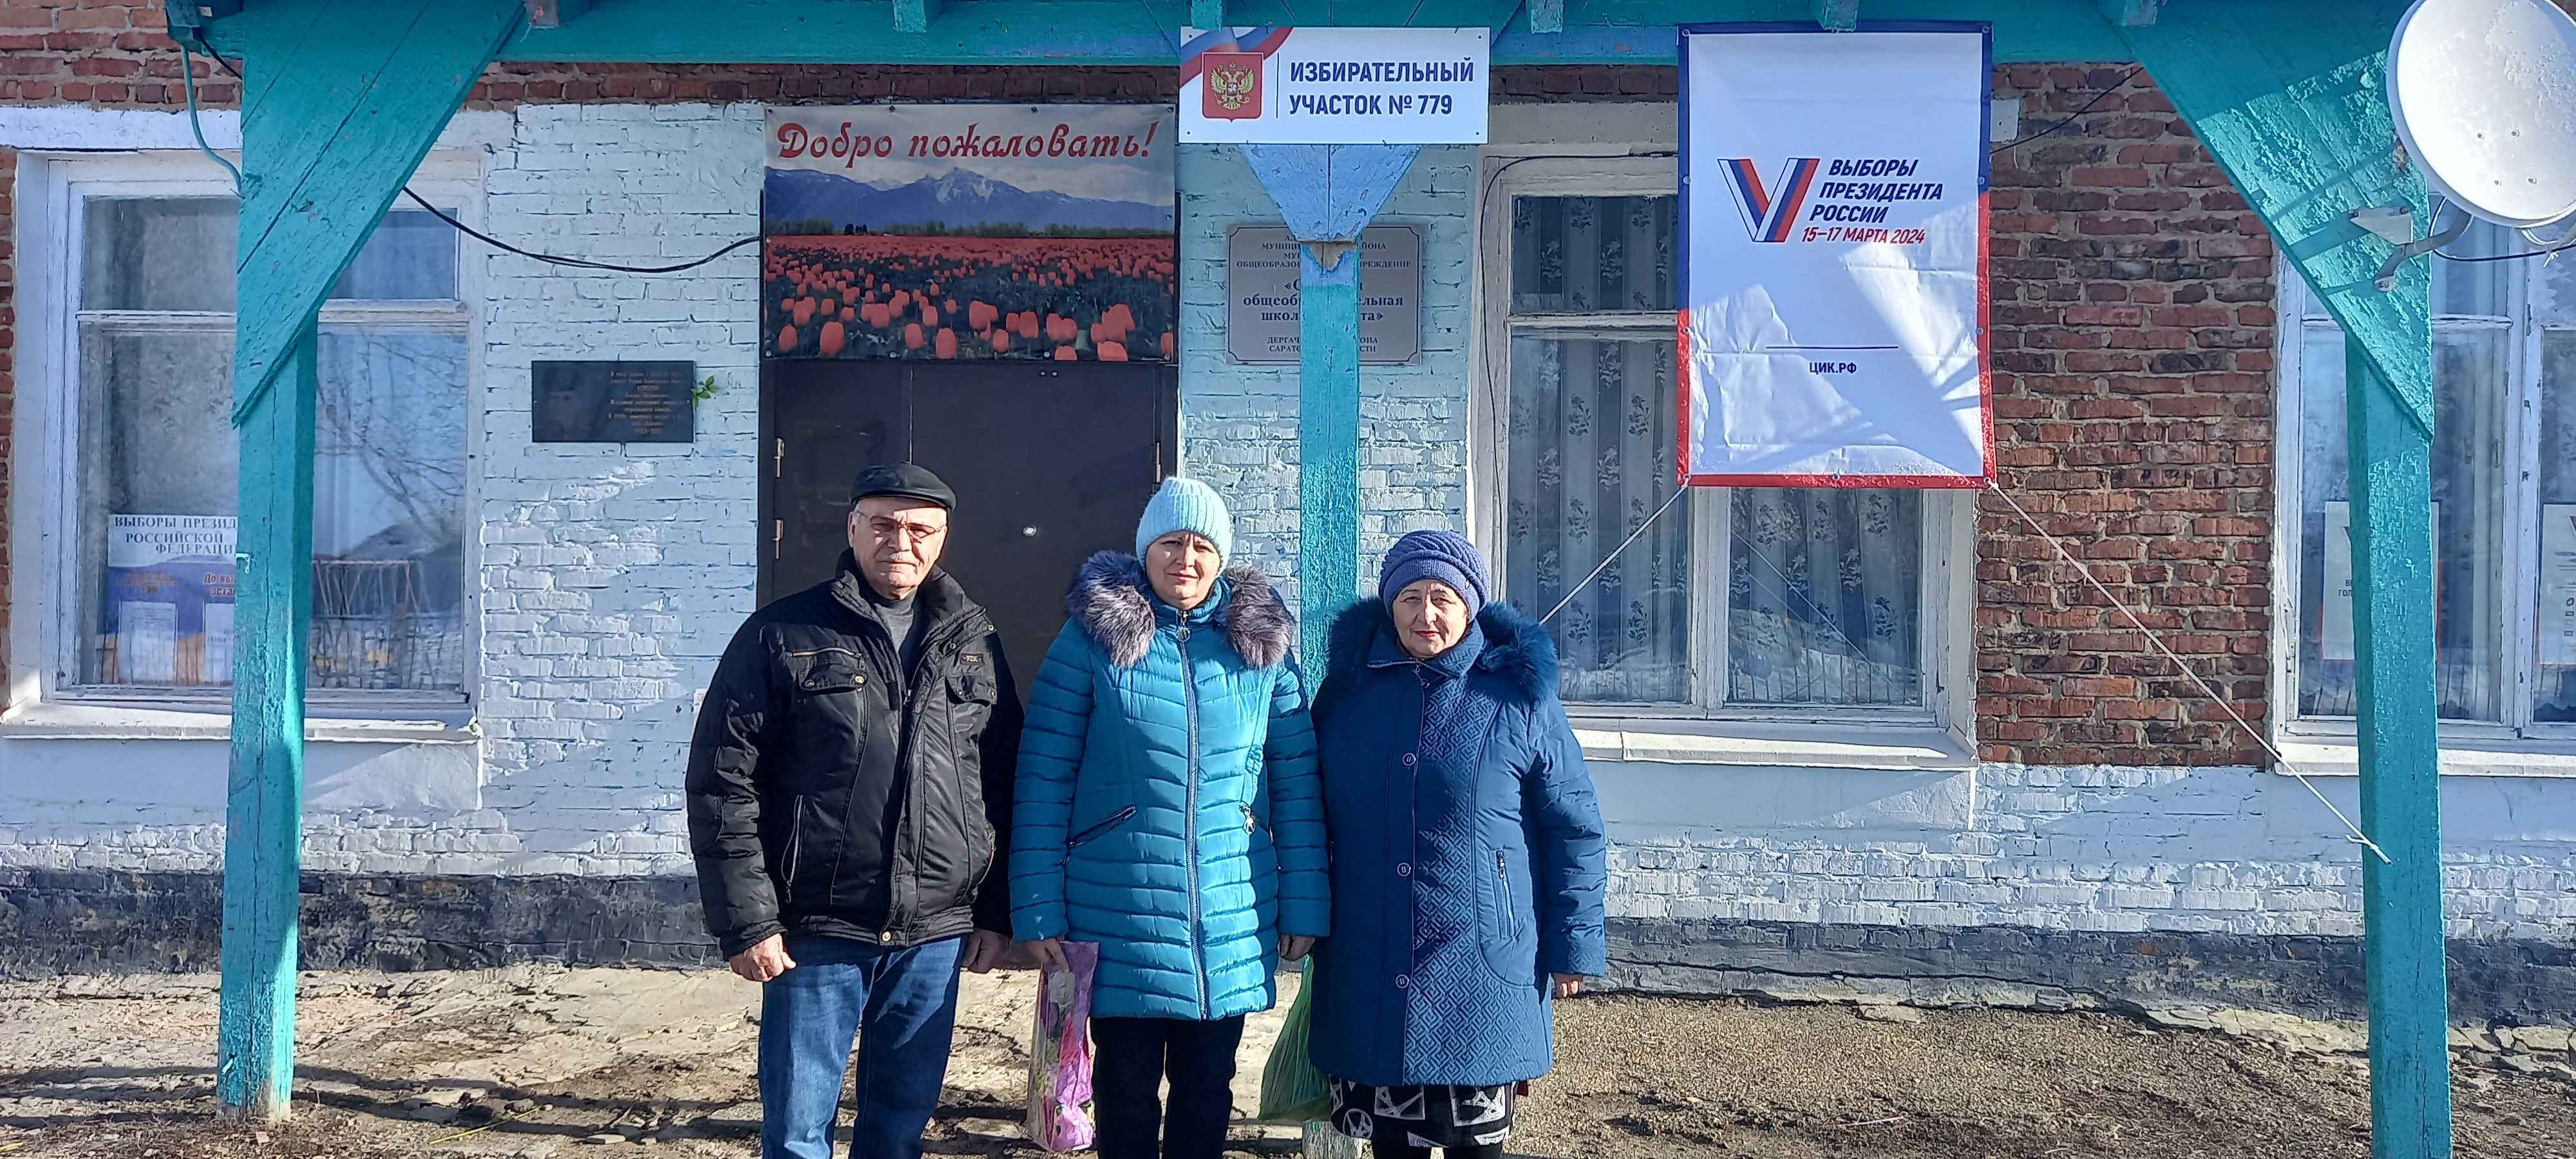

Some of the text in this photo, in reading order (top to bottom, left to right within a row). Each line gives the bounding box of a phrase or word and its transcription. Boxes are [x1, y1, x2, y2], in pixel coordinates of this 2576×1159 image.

[1290, 57, 1474, 82] ИЗБИРАТЕЛЬНЫЙ
[1289, 95, 1452, 115] УЧАСТОК № 779
[777, 121, 1160, 168] Добро пожаловать!
[1828, 159, 1919, 176] ВЫБОРЫ
[1819, 182, 1944, 202] ПРЕЗИДЕНТА
[1809, 204, 1889, 223] РОССИИ
[1842, 227, 1888, 243] МАРТА
[1889, 229, 1926, 244] 2024
[1262, 312, 1301, 321] школ
[1809, 362, 1857, 374] ЦИК.РФ
[115, 517, 237, 529] ВЫБОРЫ ПРЕЗИД
[126, 531, 223, 543] РОССИЙСКОЙ
[156, 543, 234, 554] ФЕДЕРАЦИ
[204, 573, 216, 584] До
